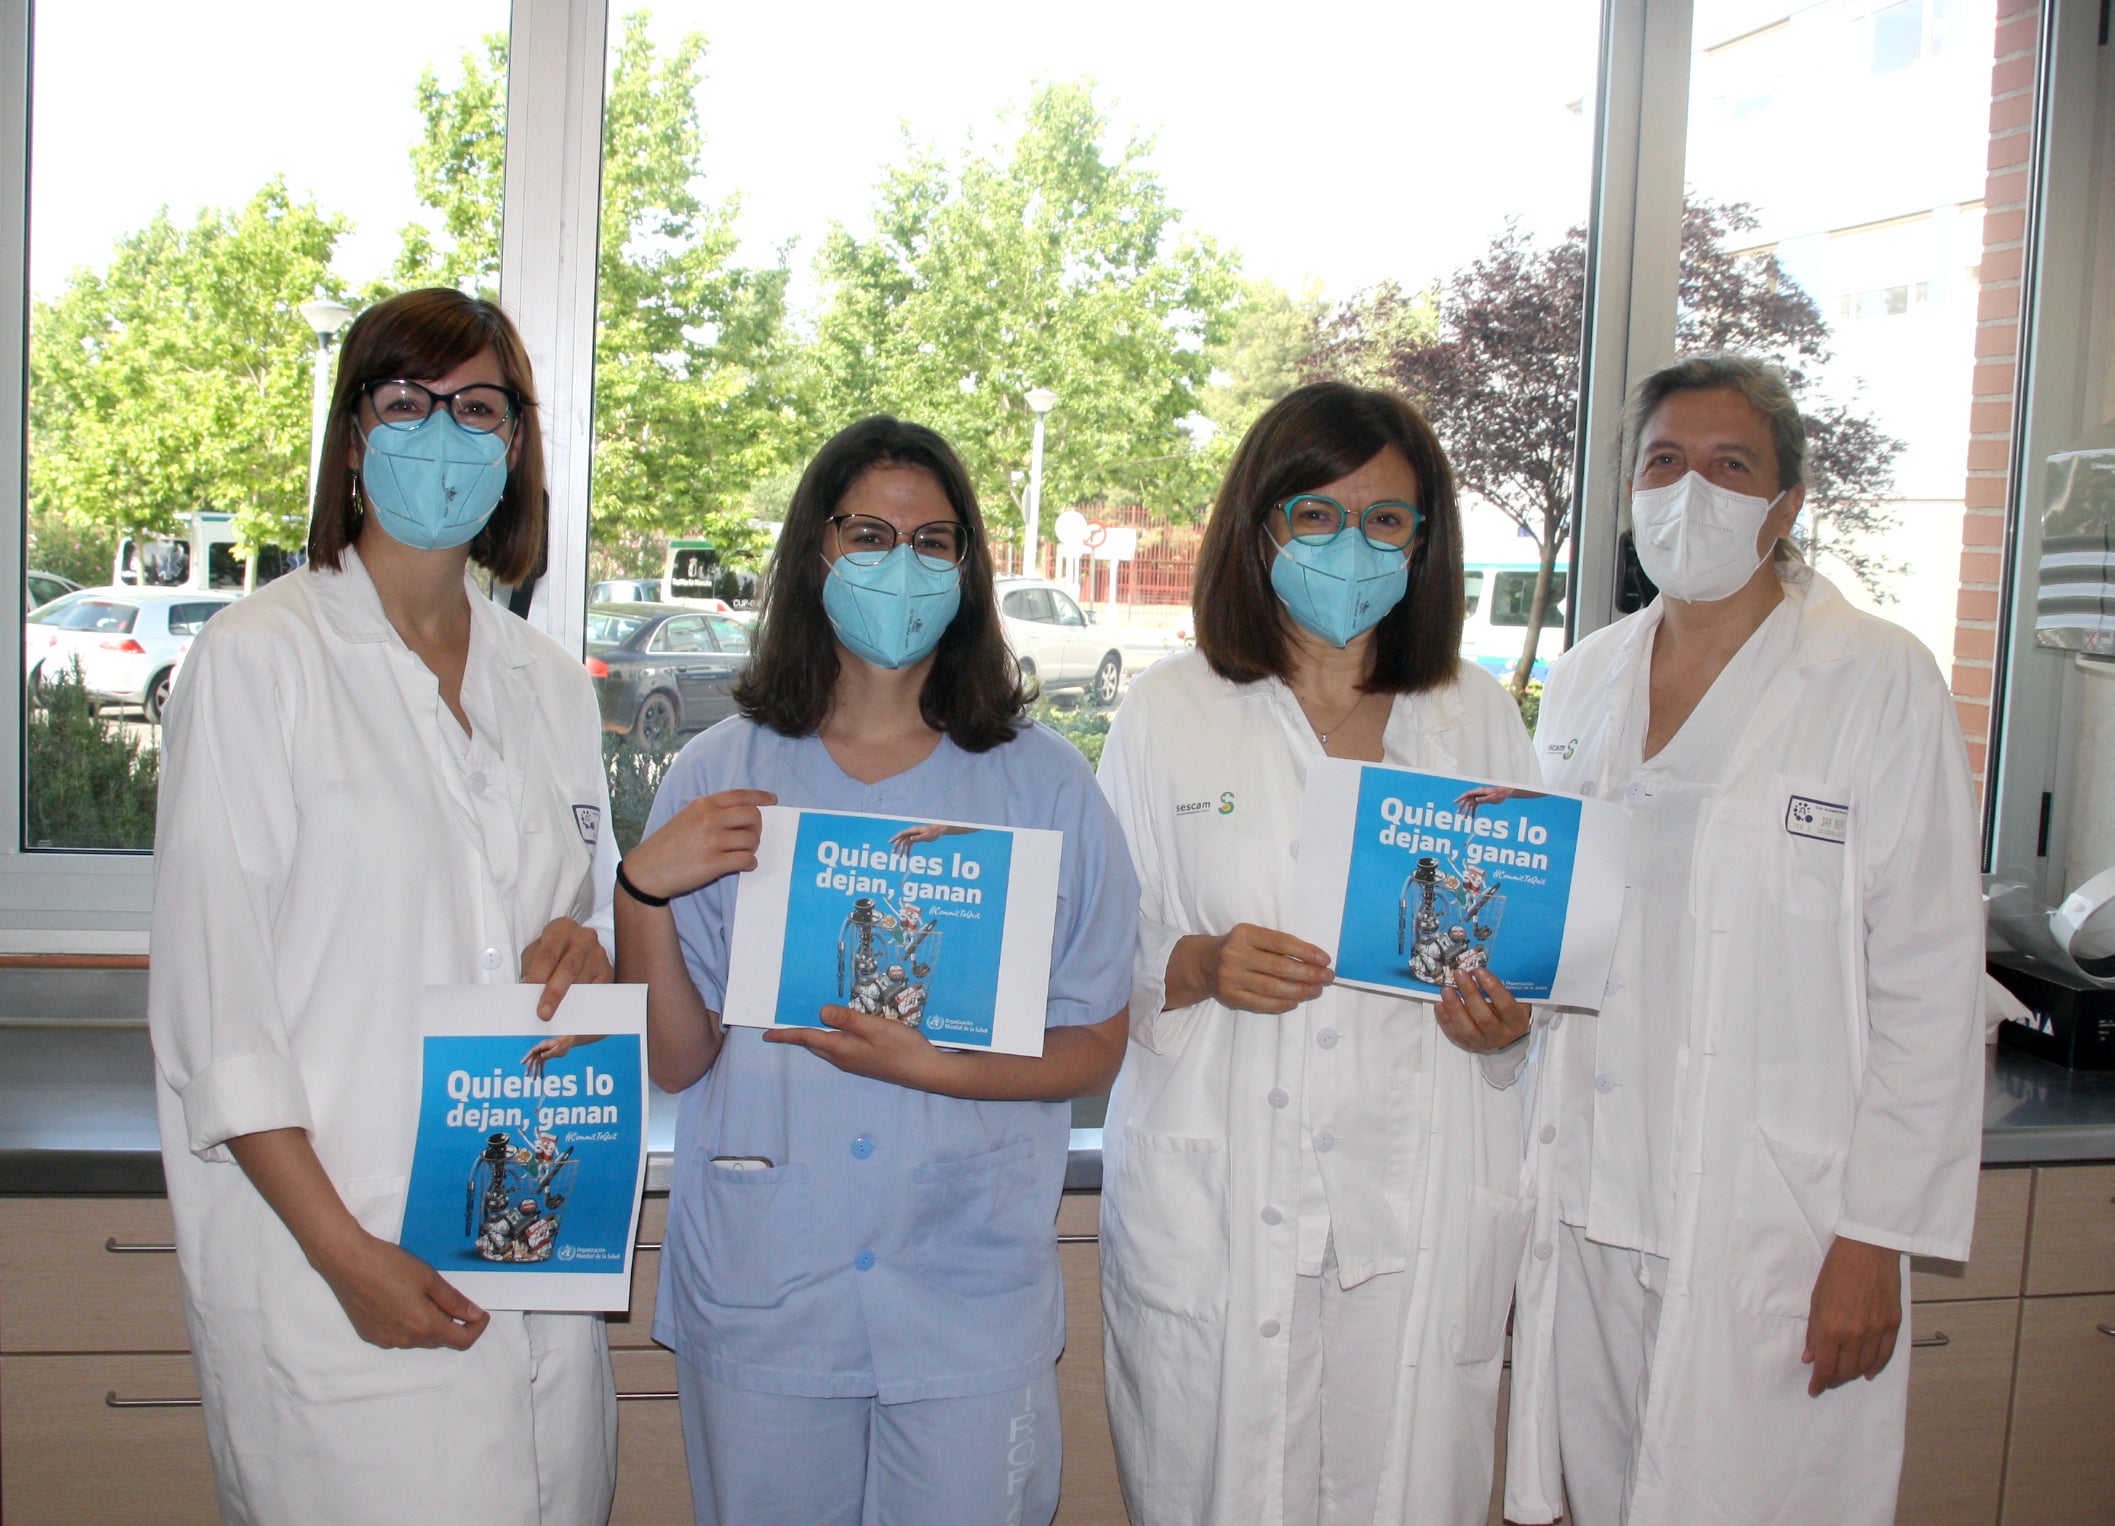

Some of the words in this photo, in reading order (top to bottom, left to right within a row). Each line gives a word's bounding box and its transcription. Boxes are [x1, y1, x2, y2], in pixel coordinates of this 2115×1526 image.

[1176, 801, 1211, 813] sescam
[1380, 796, 1510, 840] Quienes
[1517, 816, 1548, 846] lo
[817, 840, 944, 877] Quienes
[951, 852, 981, 881] lo
[1379, 824, 1460, 861] dejan,
[1466, 843, 1548, 871] ganan
[815, 866, 895, 900] dejan,
[902, 881, 983, 905] ganan
[447, 1068, 578, 1103] Quienes
[586, 1065, 614, 1097] lo
[446, 1102, 530, 1133] dejan,
[538, 1104, 618, 1133] ganan
